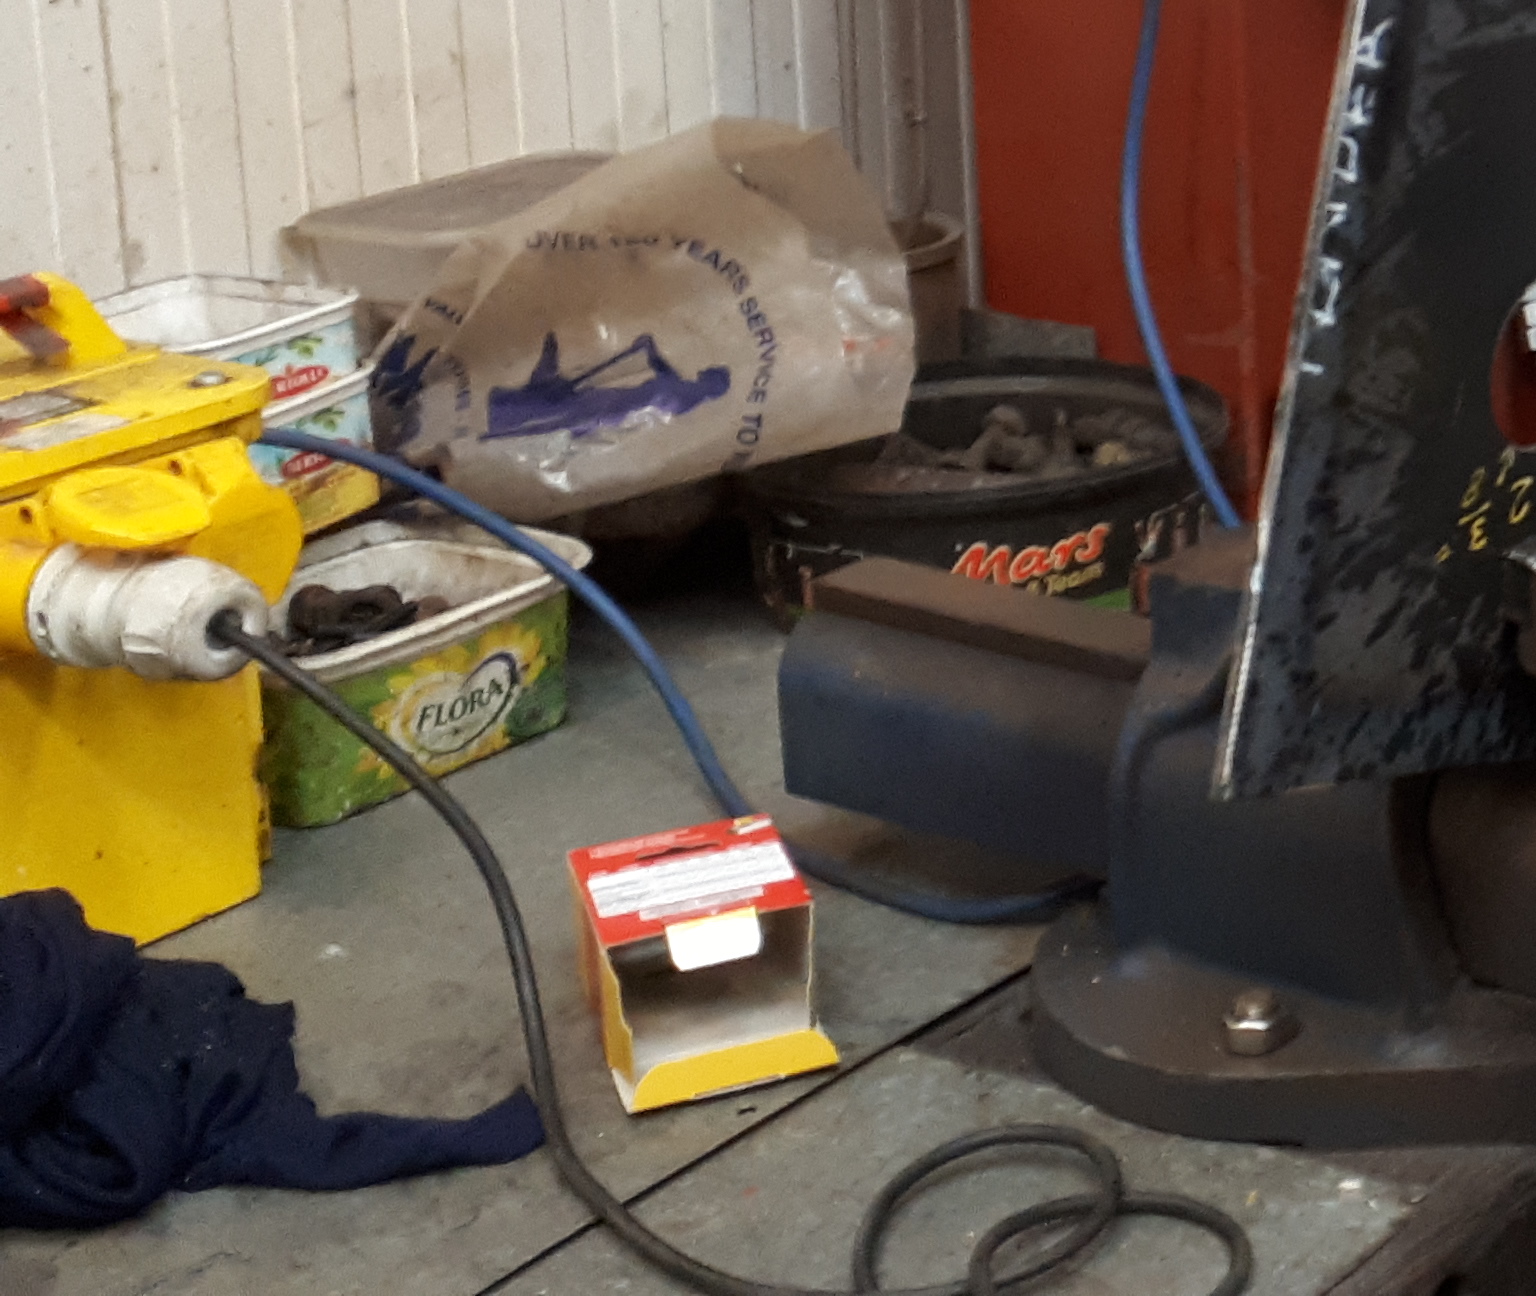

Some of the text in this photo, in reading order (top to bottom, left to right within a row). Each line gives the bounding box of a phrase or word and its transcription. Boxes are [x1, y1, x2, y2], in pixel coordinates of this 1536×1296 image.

[735, 412, 763, 446] TO
[951, 522, 1112, 585] Mars
[416, 677, 504, 733] FLORA
